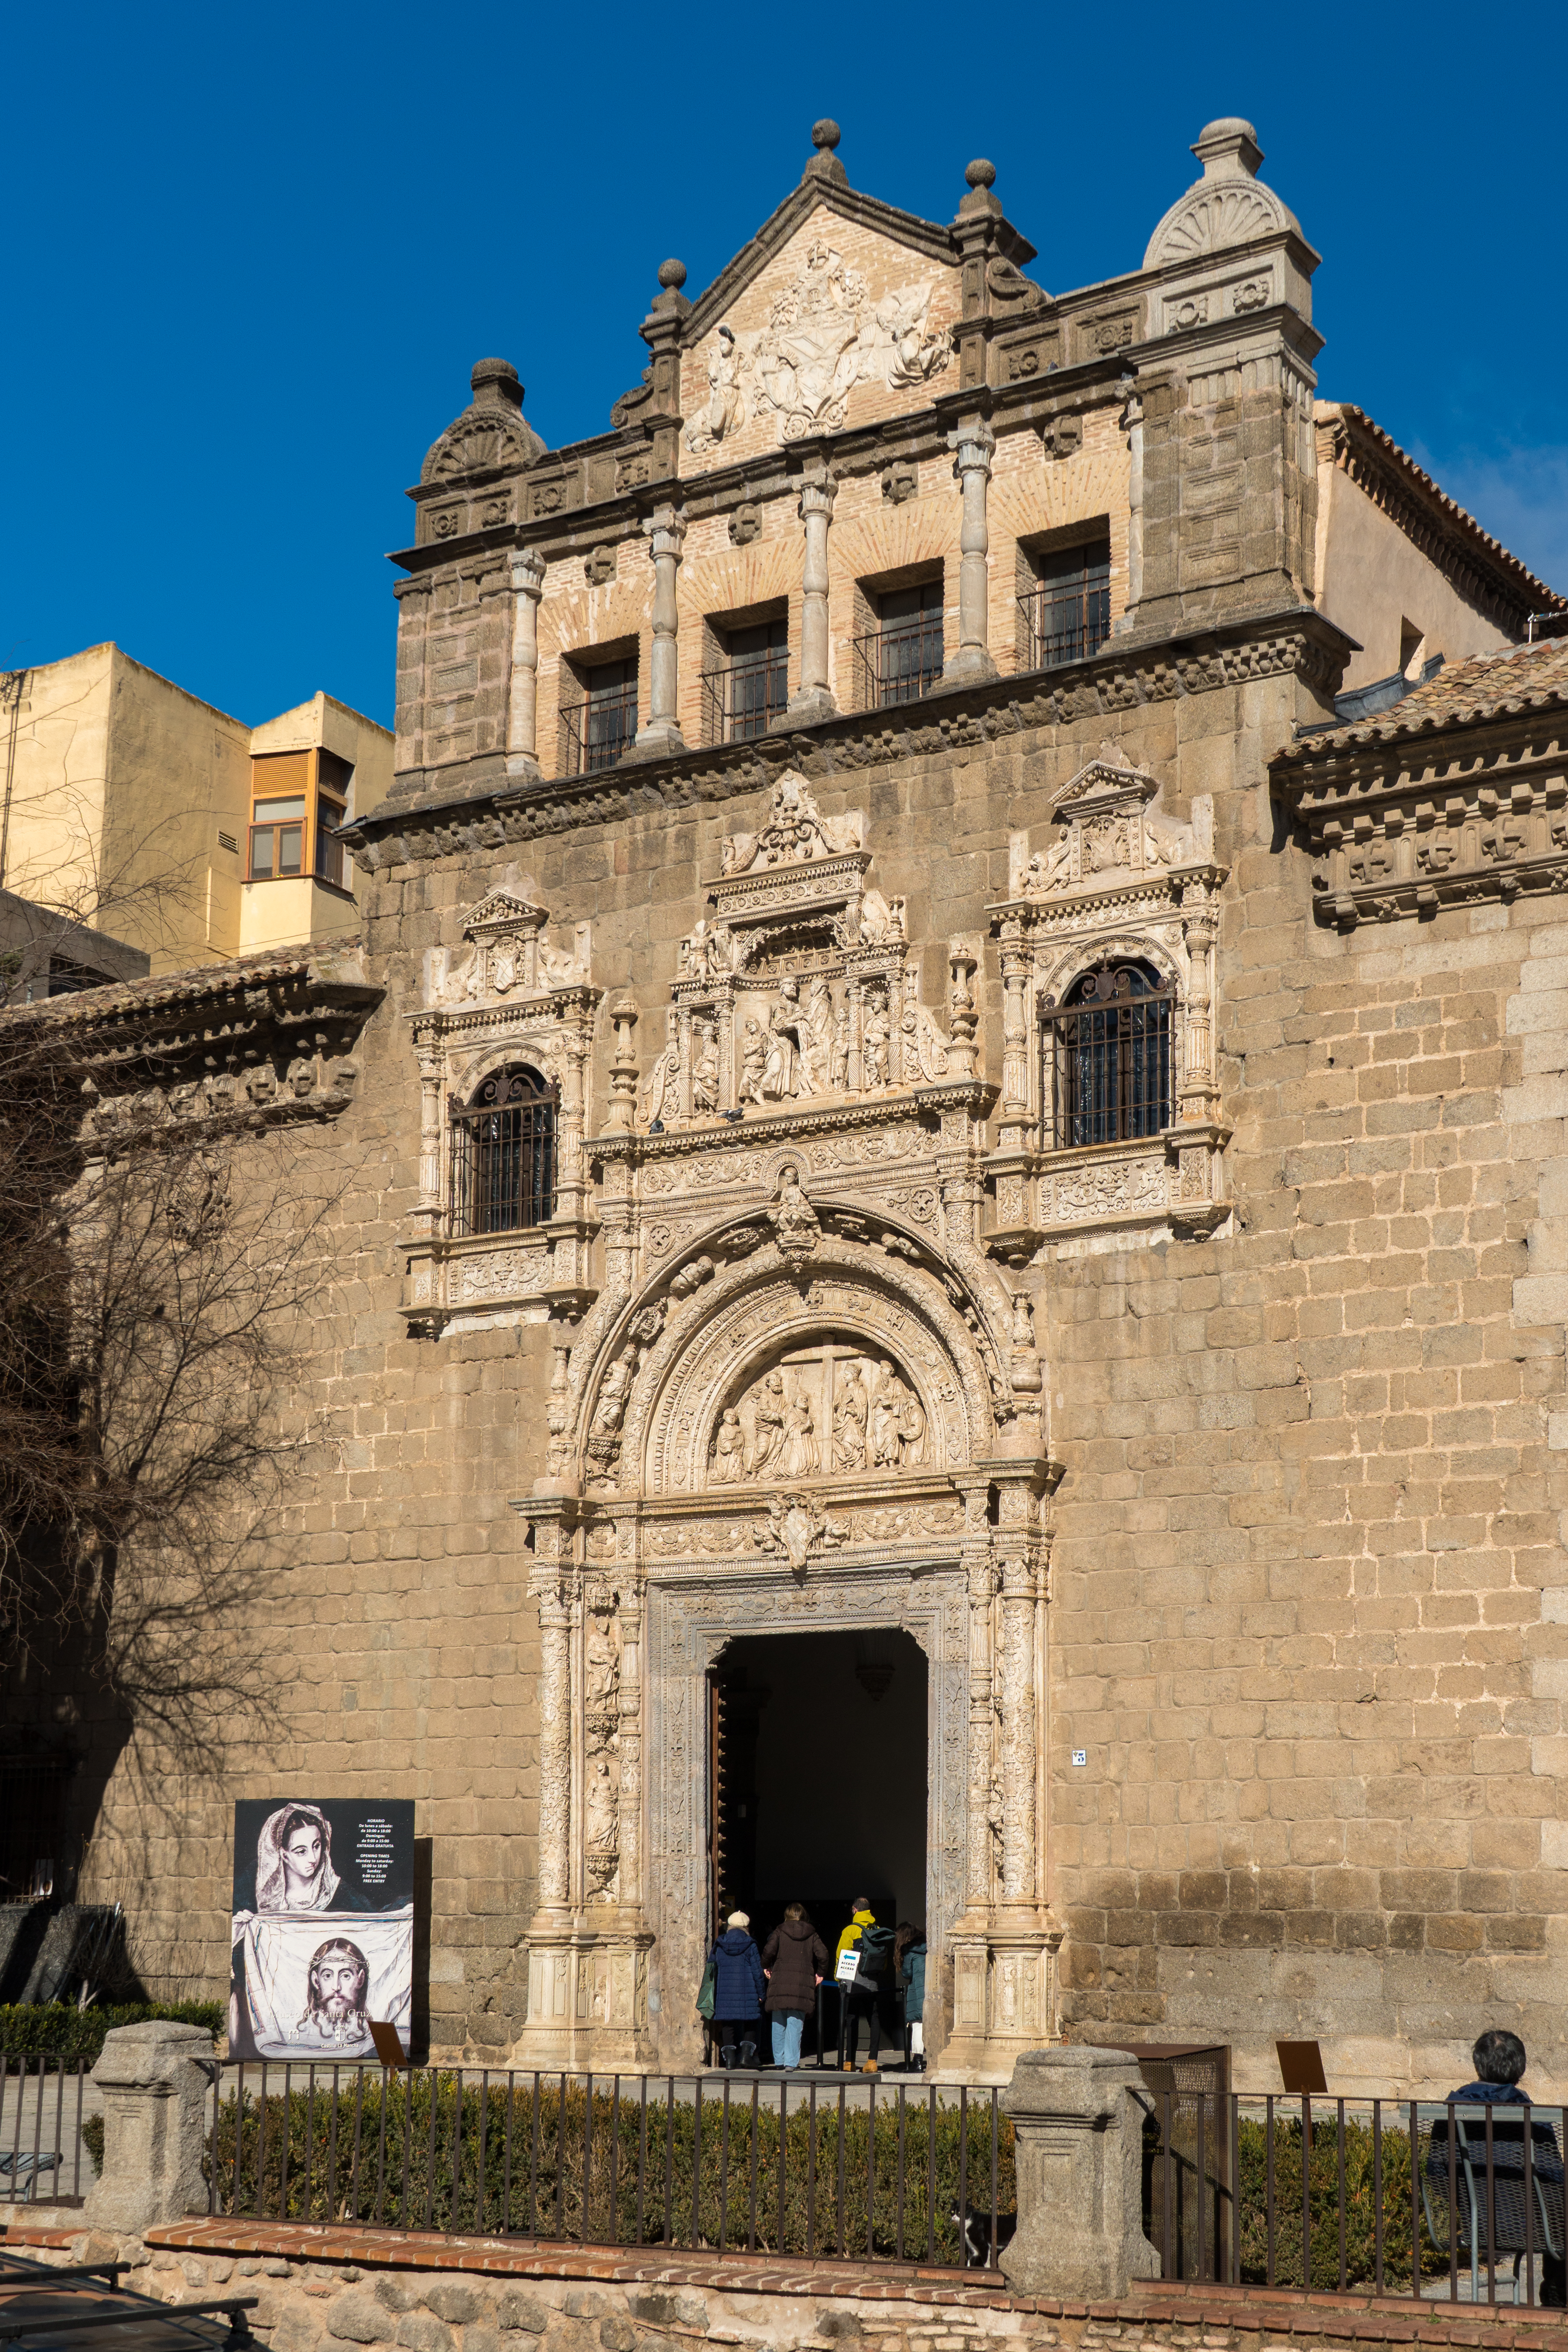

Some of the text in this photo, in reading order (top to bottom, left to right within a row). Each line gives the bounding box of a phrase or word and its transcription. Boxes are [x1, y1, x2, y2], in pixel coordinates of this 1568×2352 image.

[1078, 1753, 1084, 1762] 3
[269, 2010, 301, 2018] Museo
[319, 2009, 344, 2017] Santa
[348, 2009, 371, 2017] Cruz
